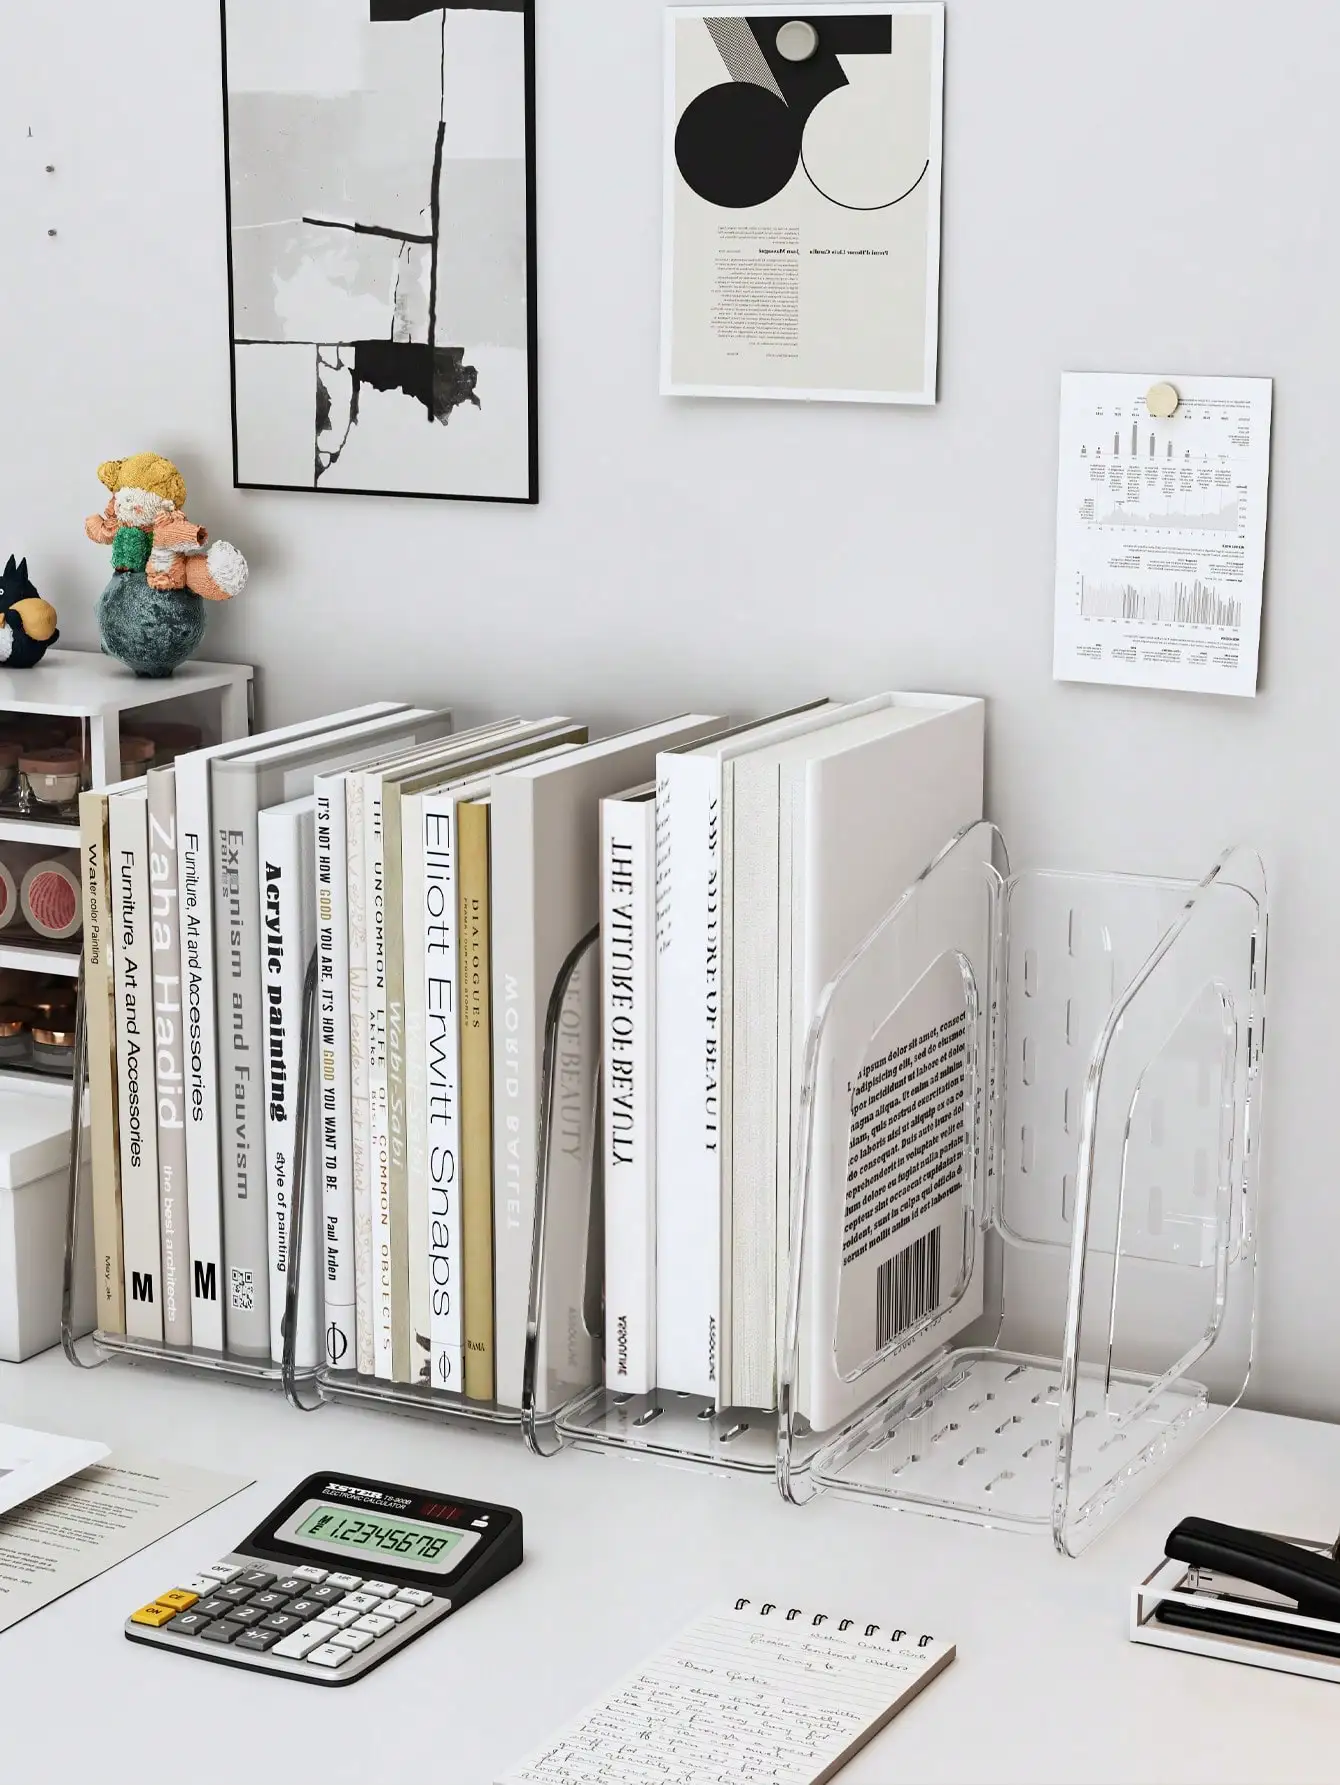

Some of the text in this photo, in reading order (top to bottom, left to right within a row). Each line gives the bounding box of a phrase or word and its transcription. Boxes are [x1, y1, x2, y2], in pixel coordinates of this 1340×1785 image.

[373, 800, 382, 841] THE
[90, 898, 98, 923] color
[374, 862, 384, 989] UNCOMMON
[91, 925, 100, 965] Painting
[149, 813, 184, 1130] Zaha Hadid
[471, 899, 480, 1029] DIALOGUES
[184, 832, 204, 1122] Furniture, Art and Accessories
[264, 861, 288, 1124] Acrylic painting
[317, 797, 338, 1193] IT'S NOT HOW GOOD YOU ARE, IT'S HOW GOOD YOU WANT TO BE.
[120, 850, 142, 1168] Furniture, Art and Accessories
[231, 992, 250, 1052] and
[560, 1010, 580, 1050] OF
[376, 1009, 386, 1069] LIFE
[425, 812, 456, 1318] Elliott Erwitt Snaps
[863, 1028, 938, 1077] ipsum dolor amet,
[389, 1001, 404, 1167] Wabi-Sabi
[856, 1067, 897, 1096] adipisicing
[914, 1048, 926, 1062] sed
[868, 1076, 907, 1106] incididunt
[916, 1059, 938, 1077] labore
[875, 1060, 962, 1118] aliqua. enim minim
[379, 1087, 387, 1116] OF
[558, 1056, 581, 1164] BEAUTY
[871, 1078, 959, 1138] quis nostrud exercitation
[234, 1065, 251, 1200] Fauvism
[860, 1105, 935, 1159] laboris nisi aliquip
[860, 1113, 952, 1174] consequat. Duis aute irure
[906, 1136, 939, 1160] voluptate
[941, 1125, 956, 1140] velit
[379, 1135, 389, 1226] COMMON
[862, 1151, 938, 1206] dolore fugiat nulla
[873, 1171, 956, 1230] sunt culpa officia
[890, 1156, 956, 1203] occaecat cupidatat
[274, 1151, 288, 1273] style of painting
[869, 1182, 962, 1248] mollit anim laborum.
[162, 1165, 177, 1322] the best architects
[325, 1215, 338, 1281] Paul Arden
[131, 1270, 155, 1304] M
[194, 1259, 217, 1301] M
[321, 1488, 407, 1510] ELECTRONIC CALCULATOR
[325, 1482, 384, 1499] XSTER
[317, 1515, 449, 1559] M 1.2345678
[145, 1607, 163, 1615] ON
[226, 1587, 311, 1609] 4 5 6
[248, 1572, 332, 1596] 7 8 9
[181, 1616, 198, 1624] 0
[205, 1601, 289, 1625] 1 2 3
